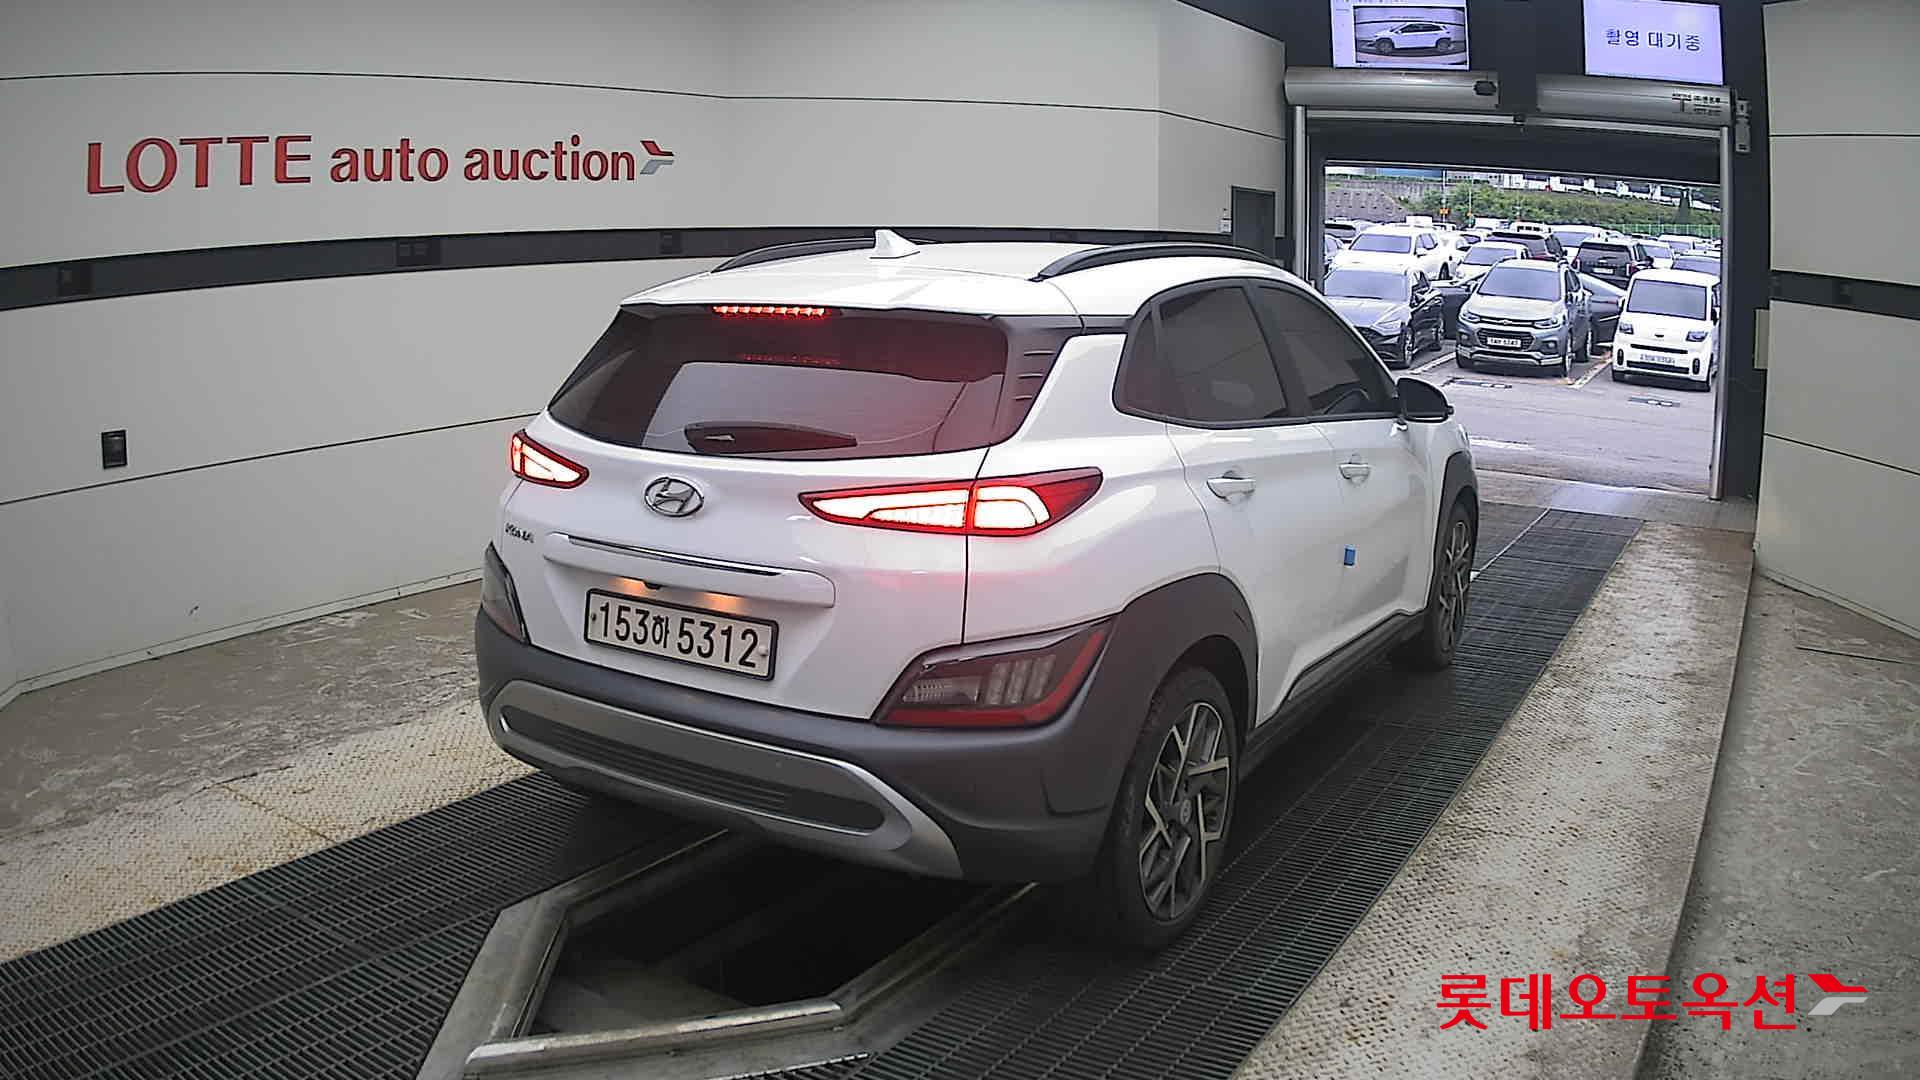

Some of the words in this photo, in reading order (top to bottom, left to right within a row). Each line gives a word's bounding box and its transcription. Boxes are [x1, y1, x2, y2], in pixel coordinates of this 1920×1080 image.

[1606, 29, 1639, 47] 촬영
[87, 135, 312, 194] LOTTE
[329, 138, 449, 182] auto
[463, 134, 635, 181] auction
[600, 601, 669, 648] 153하
[677, 617, 758, 668] 5312
